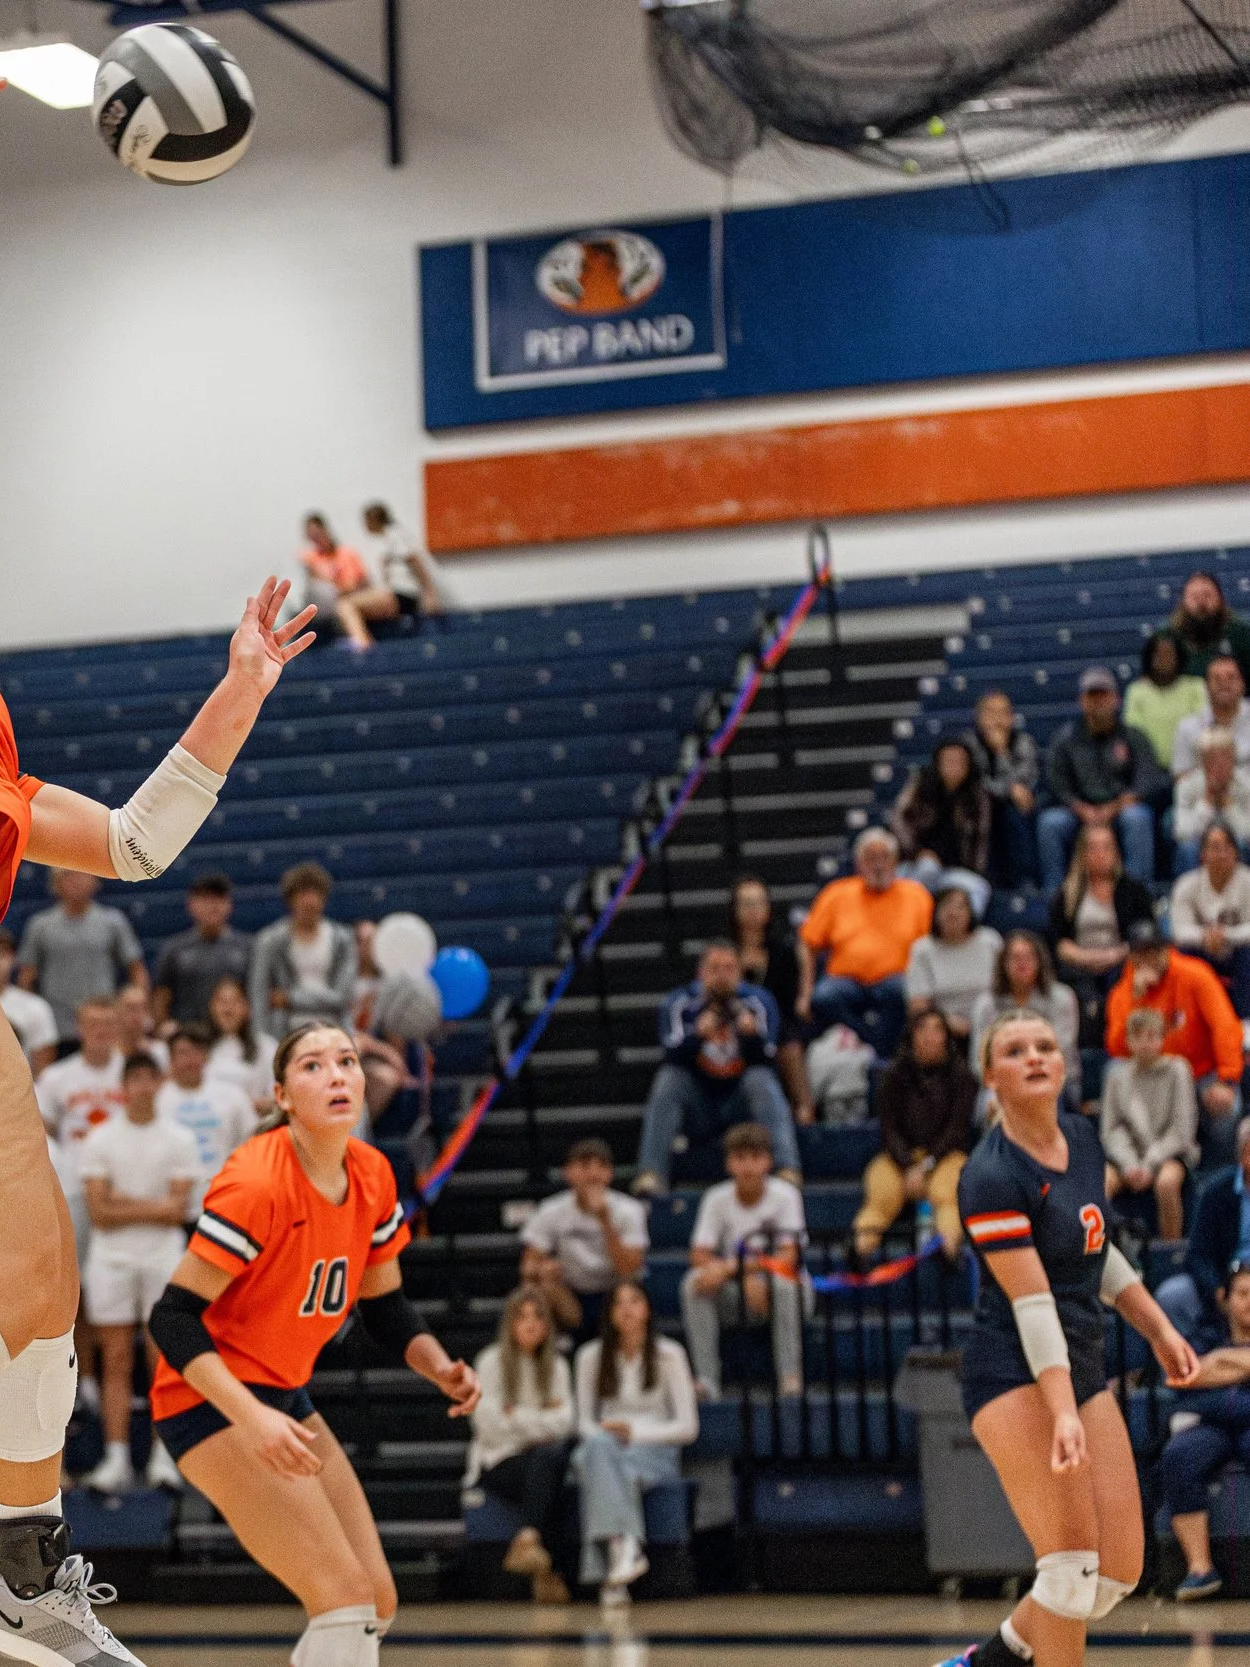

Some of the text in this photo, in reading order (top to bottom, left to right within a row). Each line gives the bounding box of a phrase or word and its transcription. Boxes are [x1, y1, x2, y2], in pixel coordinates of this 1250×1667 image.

[524, 314, 695, 364] PEP BAND
[1079, 1203, 1106, 1255] 2
[299, 1256, 349, 1317] 10
